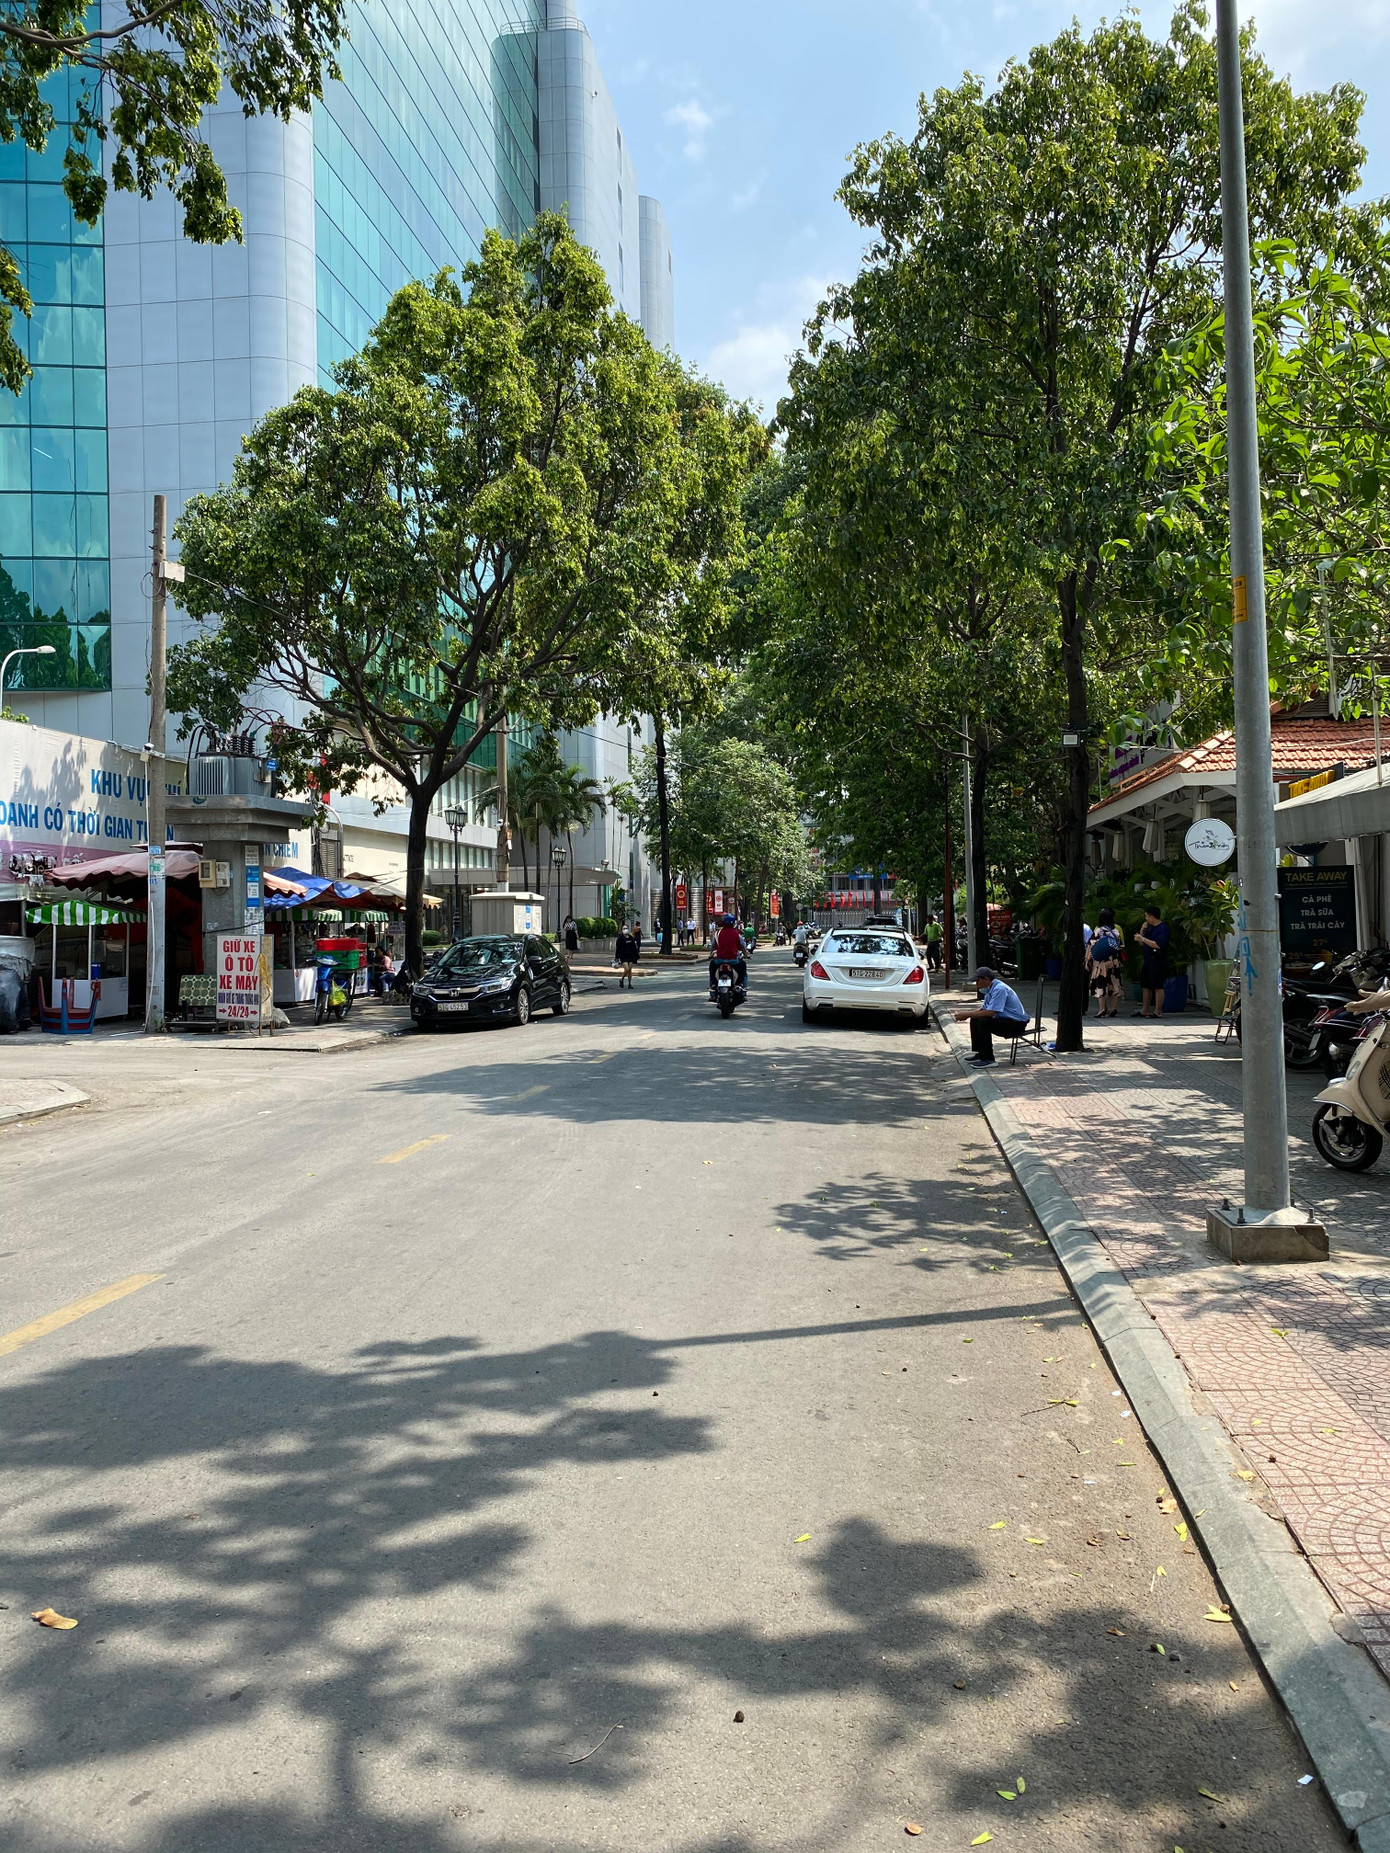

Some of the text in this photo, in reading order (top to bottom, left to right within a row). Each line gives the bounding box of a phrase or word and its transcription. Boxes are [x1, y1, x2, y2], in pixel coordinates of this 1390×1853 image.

[91, 769, 122, 798] KHU
[128, 774, 151, 806] VỰ
[44, 802, 63, 831] CÓ
[68, 807, 99, 836] THỜI
[105, 815, 132, 840] GIAN
[1284, 871, 1347, 883] TAKE AWAY
[1301, 894, 1332, 904] CÀ PHÊ
[1300, 908, 1316, 917] TRÀ
[1290, 922, 1306, 930] TRÀ
[223, 939, 255, 953] GIỮ XE
[225, 954, 254, 972] Ô TÔ
[219, 973, 258, 990] XE MÁY
[228, 1005, 249, 1018] 24/24
